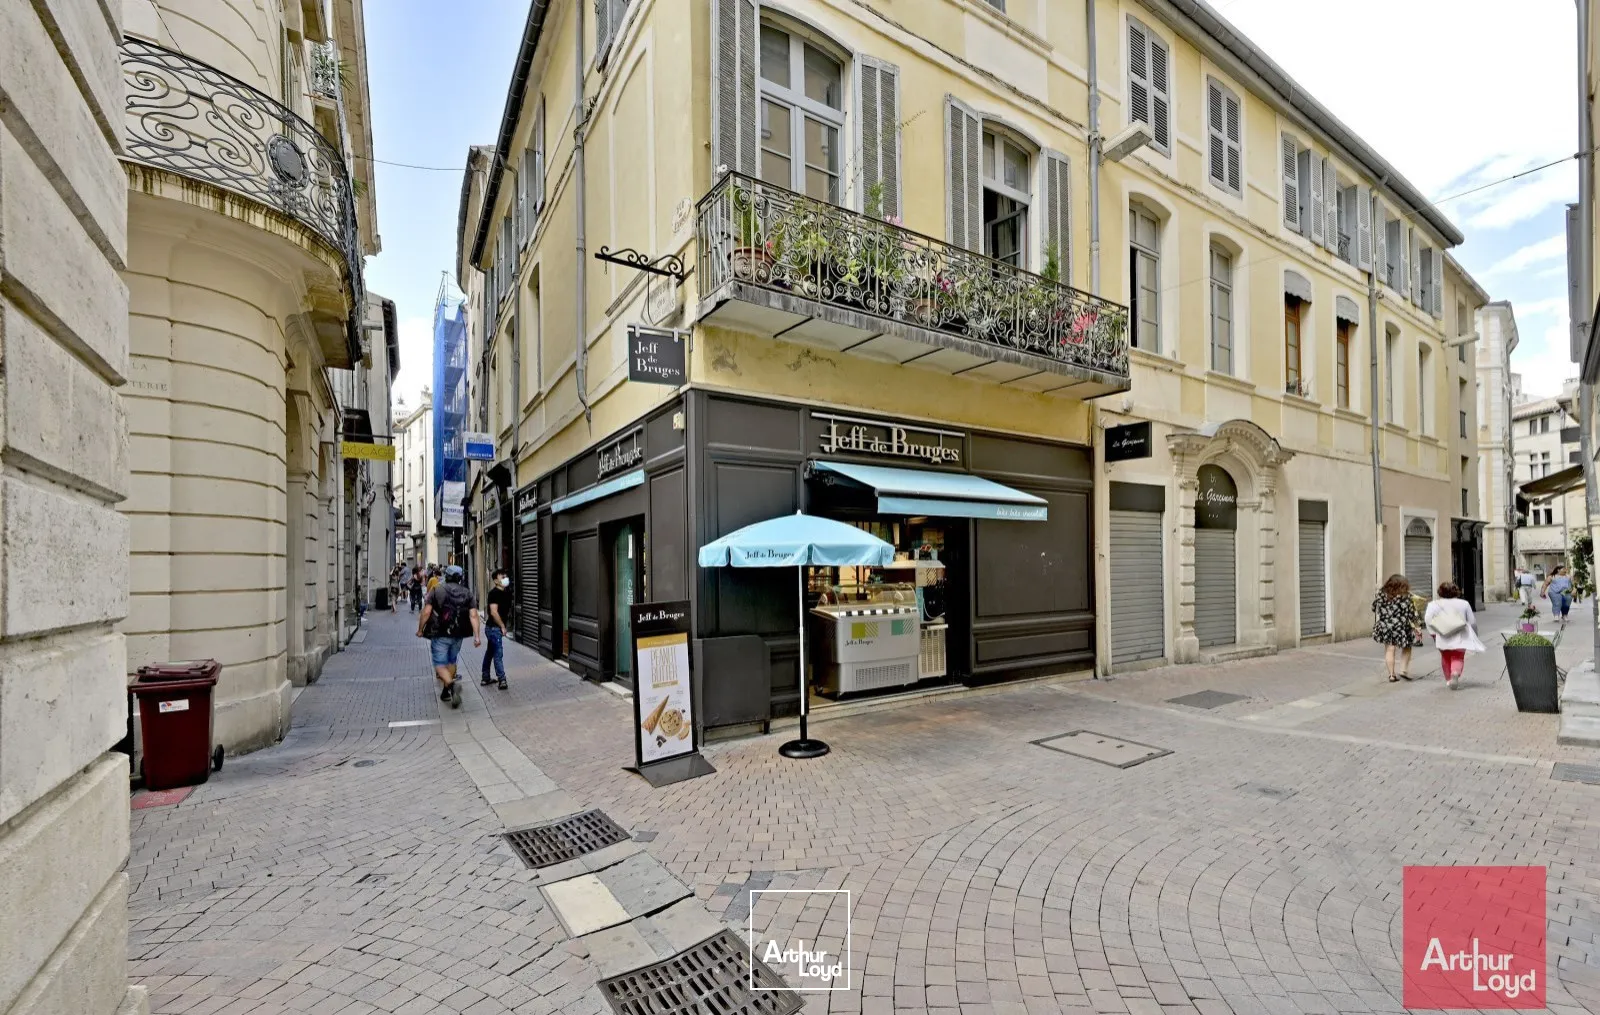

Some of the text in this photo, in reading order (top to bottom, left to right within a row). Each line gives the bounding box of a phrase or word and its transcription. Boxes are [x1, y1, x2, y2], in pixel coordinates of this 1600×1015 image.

[634, 341, 659, 354] Jeff
[647, 355, 658, 363] de
[636, 357, 680, 378] Bruges
[821, 422, 960, 464] Jeff de Bruges
[637, 612, 651, 624] Jeff
[659, 609, 685, 620] Bruges
